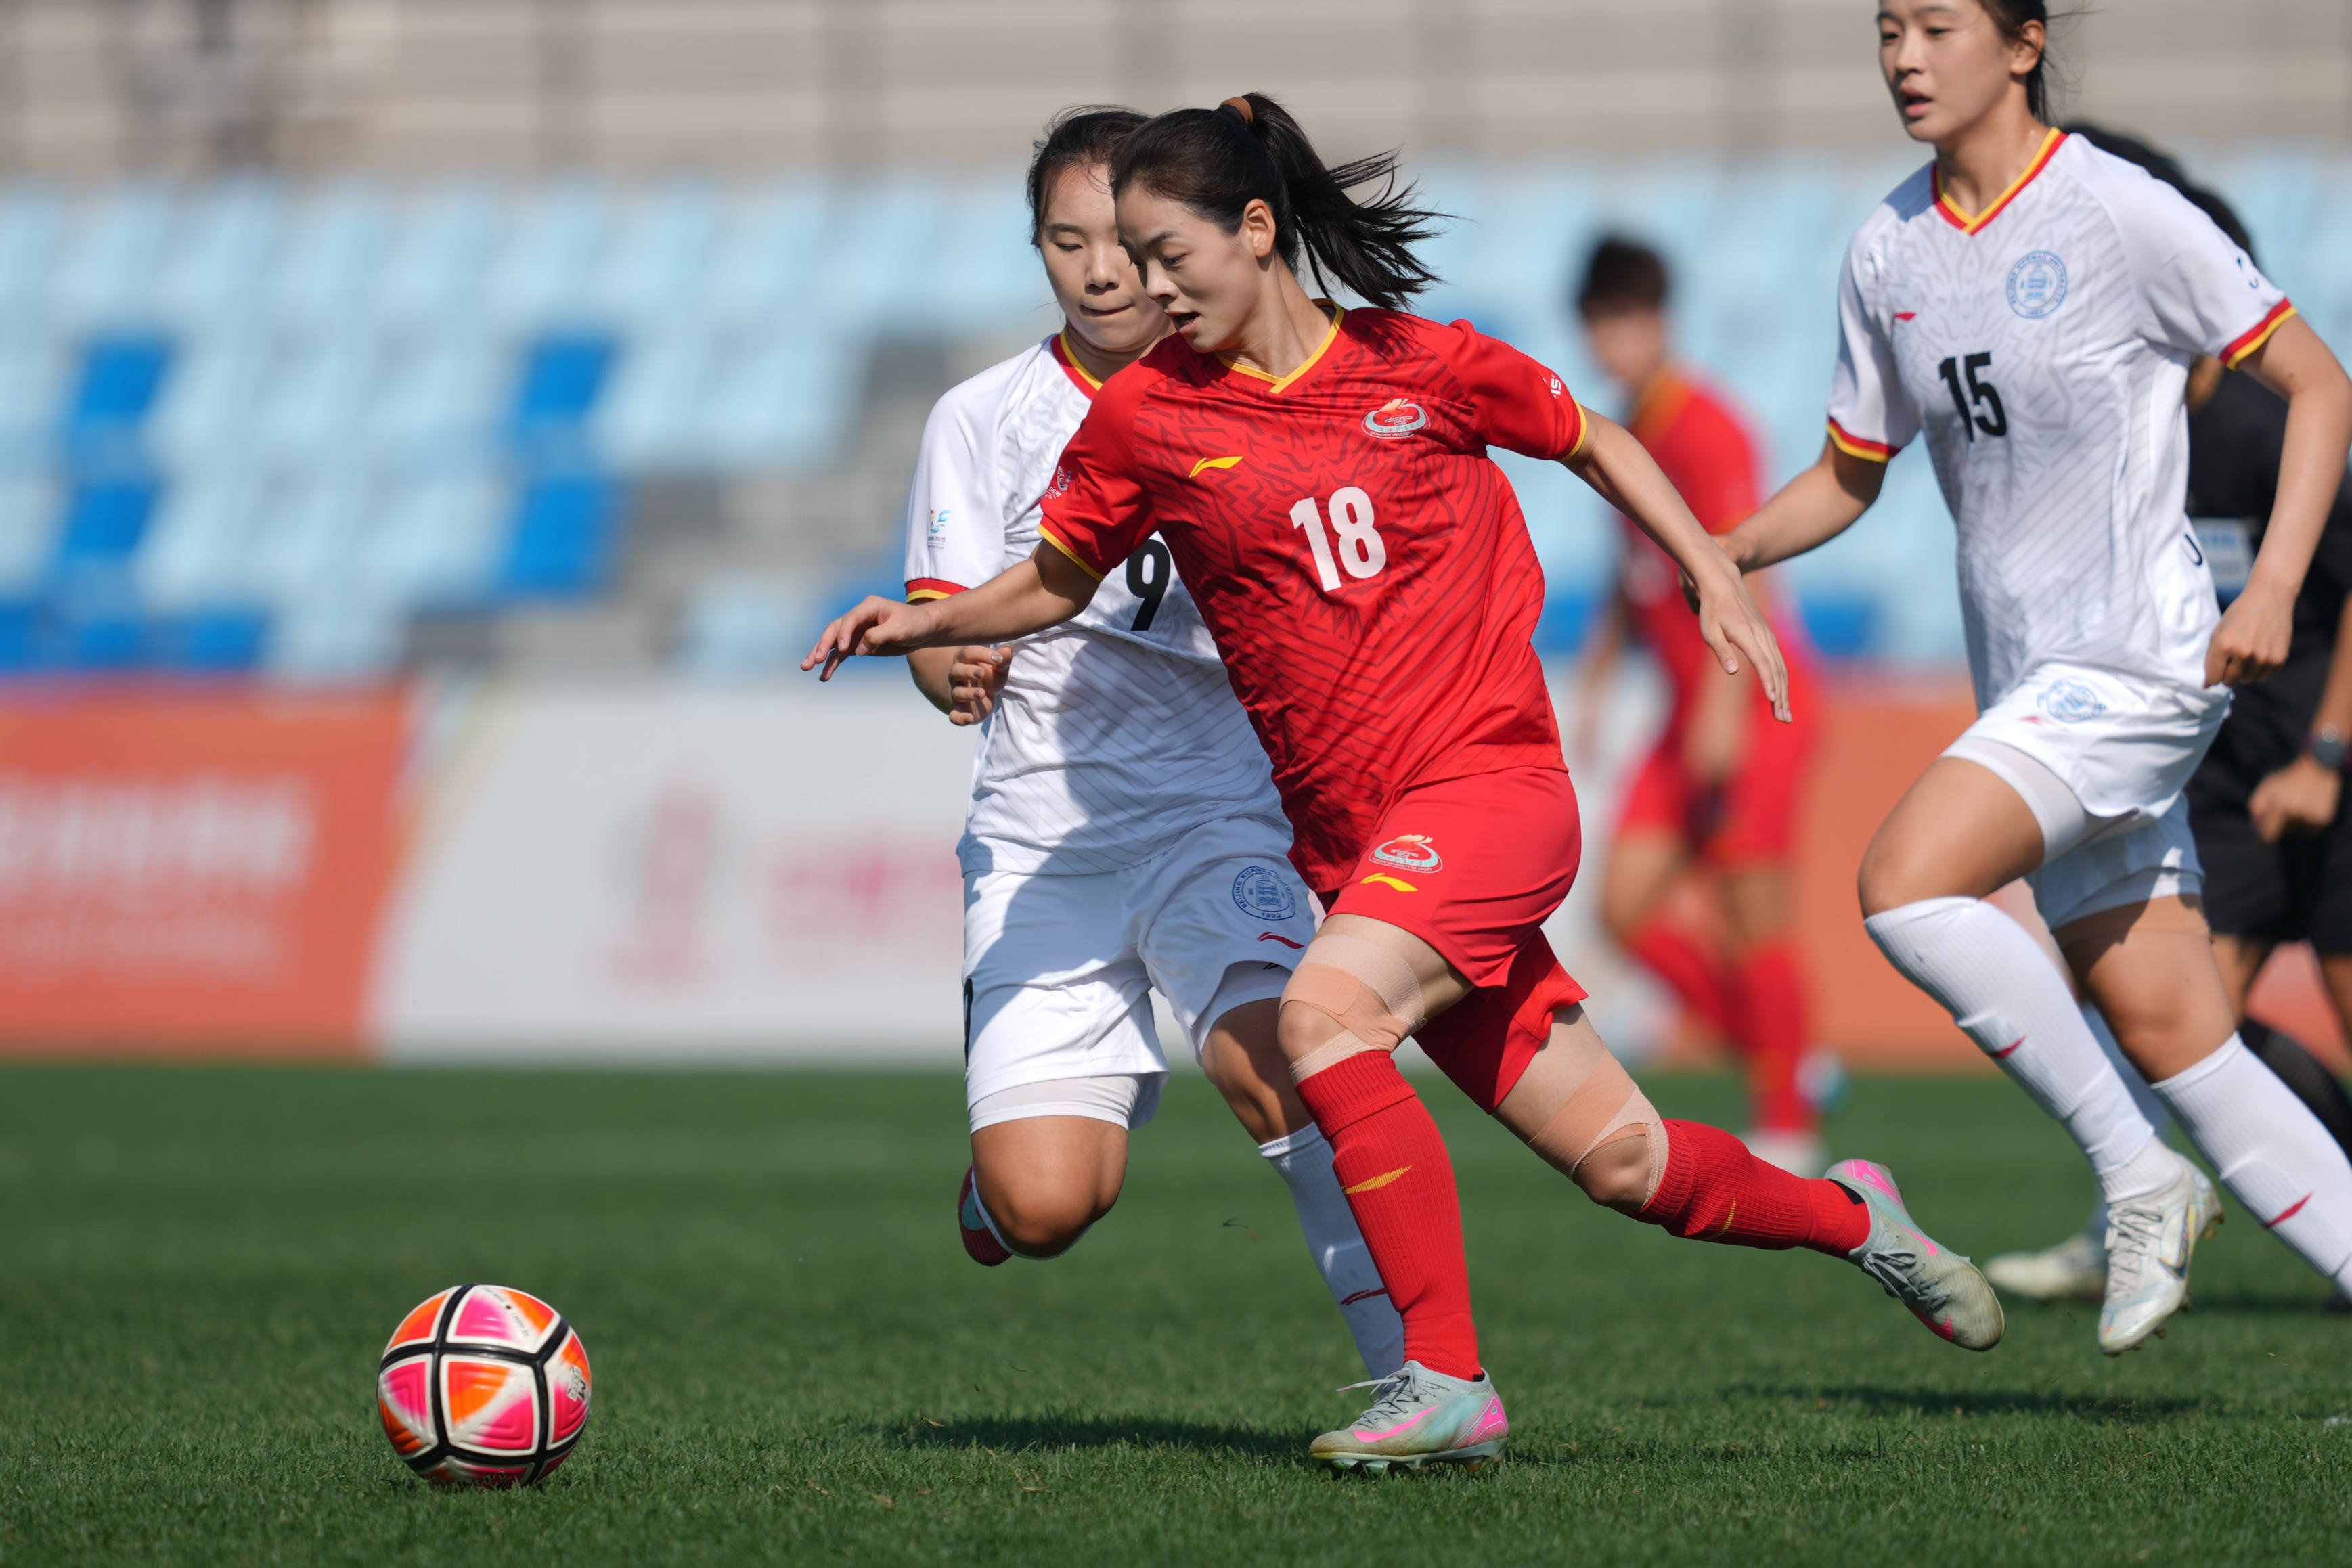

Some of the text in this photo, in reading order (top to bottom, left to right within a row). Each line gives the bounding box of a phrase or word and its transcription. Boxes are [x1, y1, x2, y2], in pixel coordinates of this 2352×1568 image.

[1938, 351, 2007, 443] 15
[1125, 539, 1171, 631] 9
[1289, 486, 1387, 592] 18
[1235, 881, 1248, 908] BEIJING
